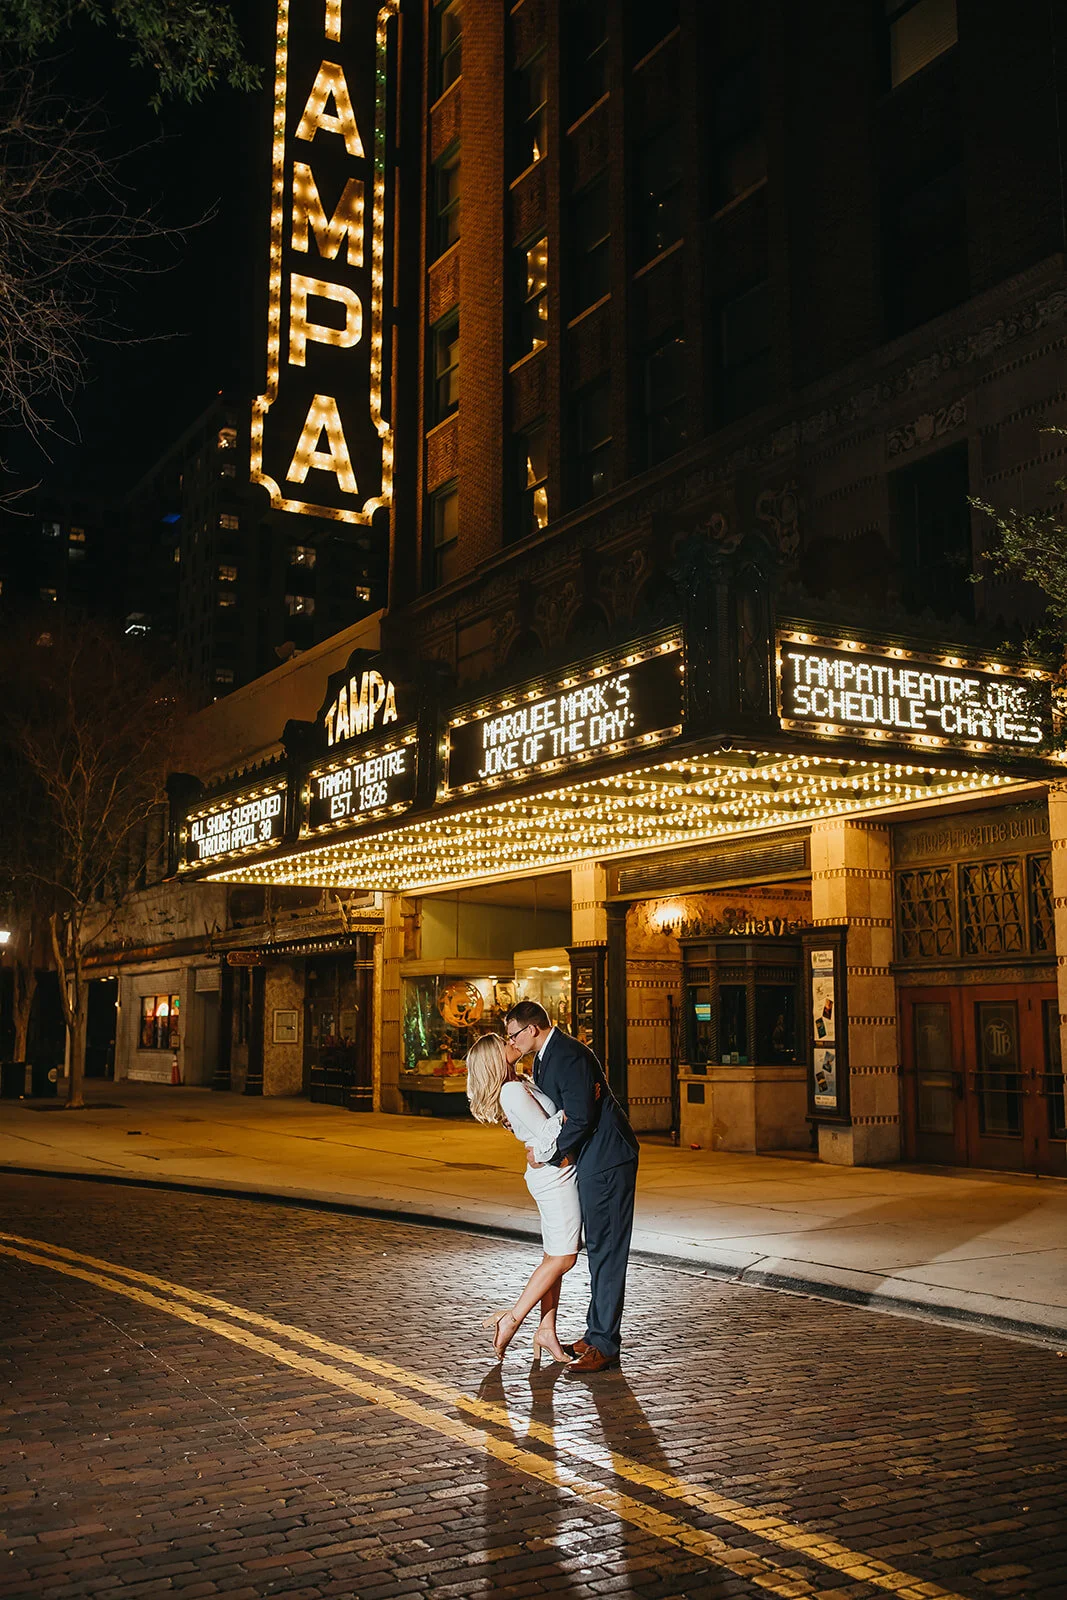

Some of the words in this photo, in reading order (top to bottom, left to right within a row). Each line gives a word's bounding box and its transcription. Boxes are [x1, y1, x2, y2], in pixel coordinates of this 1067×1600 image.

[324, 670, 398, 747] TAMPA
[483, 699, 557, 749] MARQUEE
[560, 673, 630, 724] MARK'S
[478, 740, 519, 777] JOKE
[522, 732, 546, 765] OF
[550, 720, 586, 757] THE
[589, 706, 635, 747] DAY:
[317, 768, 352, 800] TAMPA
[353, 748, 406, 791] THEATRE
[330, 794, 355, 820] EST.
[359, 780, 389, 811] 1926
[191, 820, 206, 842] ALL
[206, 810, 231, 836] SHOWS
[231, 793, 281, 829] SUSPENDED
[197, 830, 231, 858] THROUGH
[231, 823, 258, 850] APRIL
